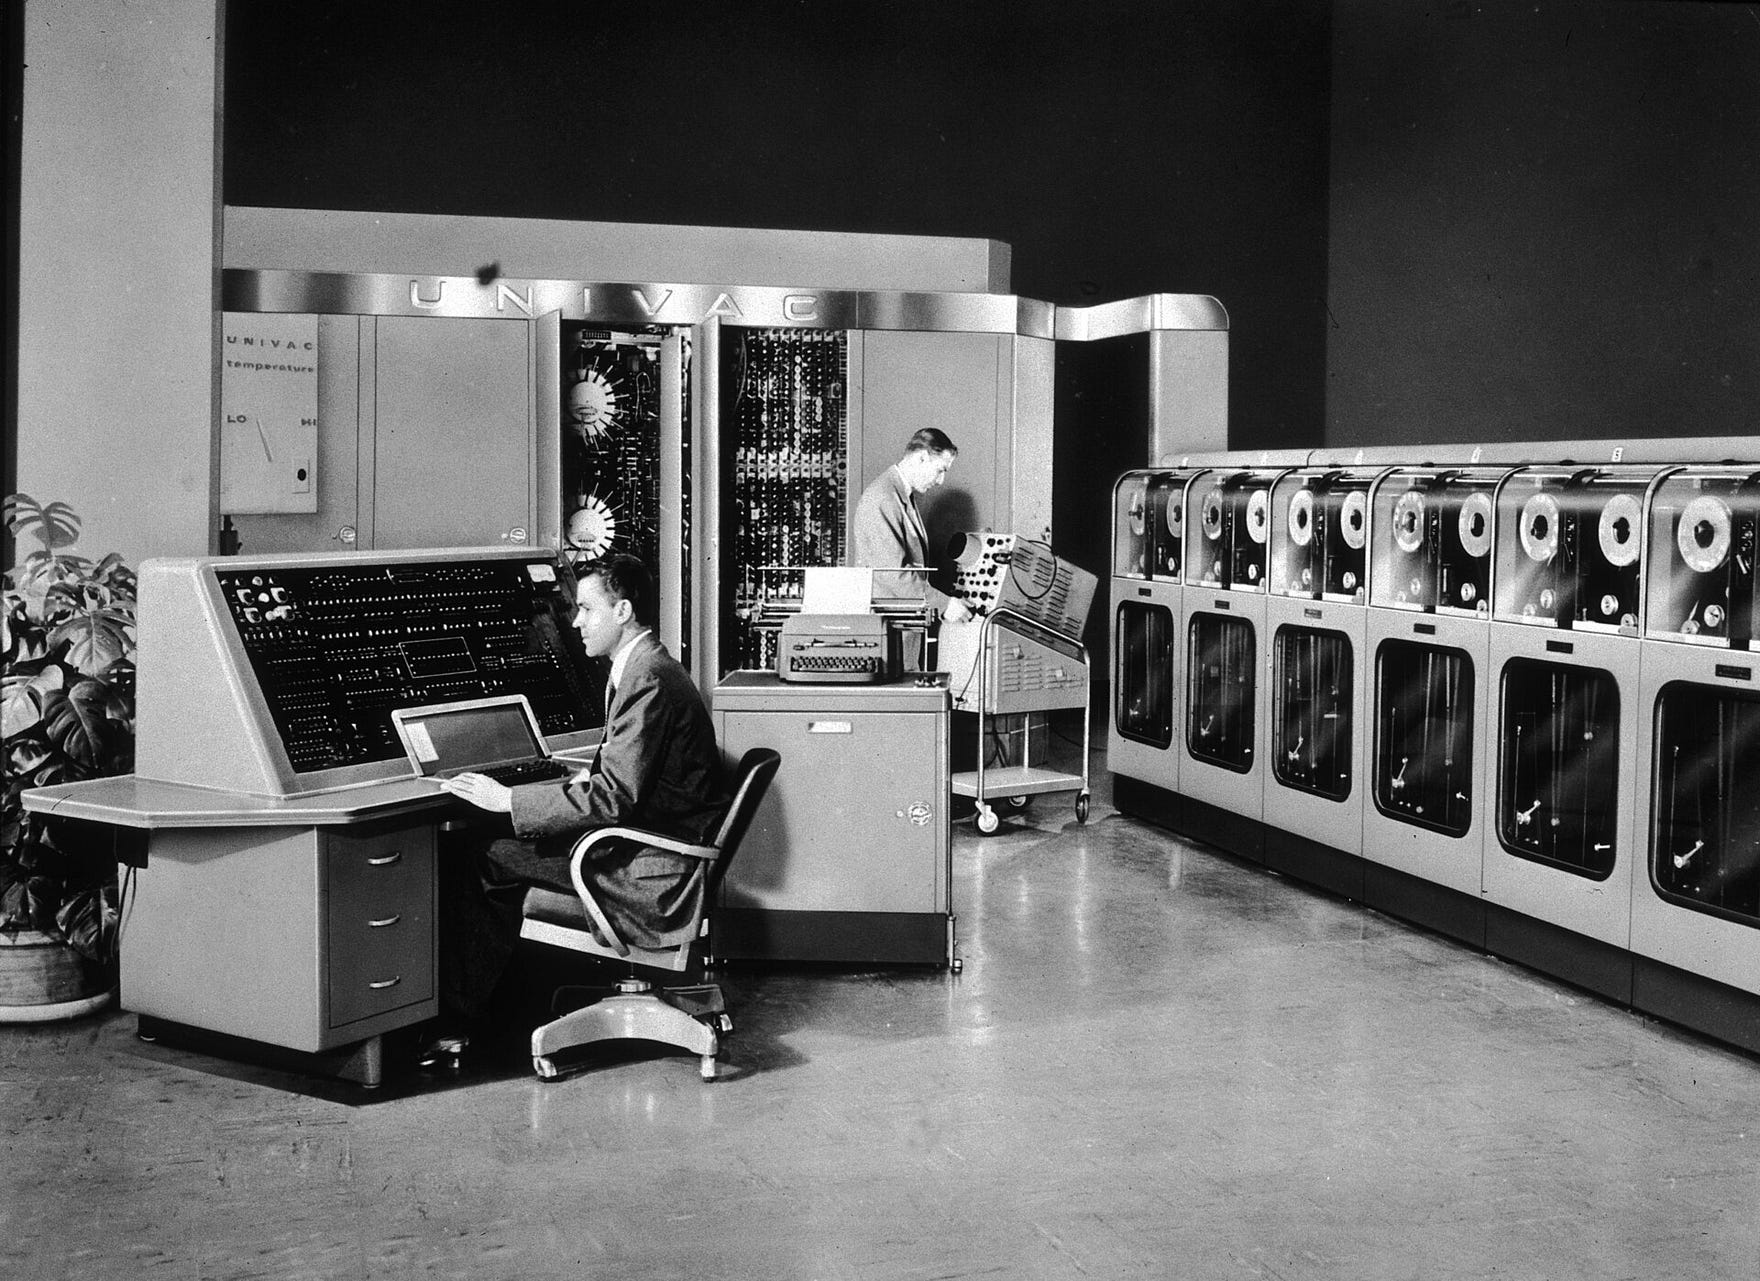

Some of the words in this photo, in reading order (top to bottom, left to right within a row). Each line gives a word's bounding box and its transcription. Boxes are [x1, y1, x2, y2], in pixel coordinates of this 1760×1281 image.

[410, 280, 818, 322] UNIVAC
[226, 336, 313, 350] UNIVAC
[226, 360, 314, 373] temperature
[227, 415, 247, 424] LO
[301, 418, 317, 426] HI
